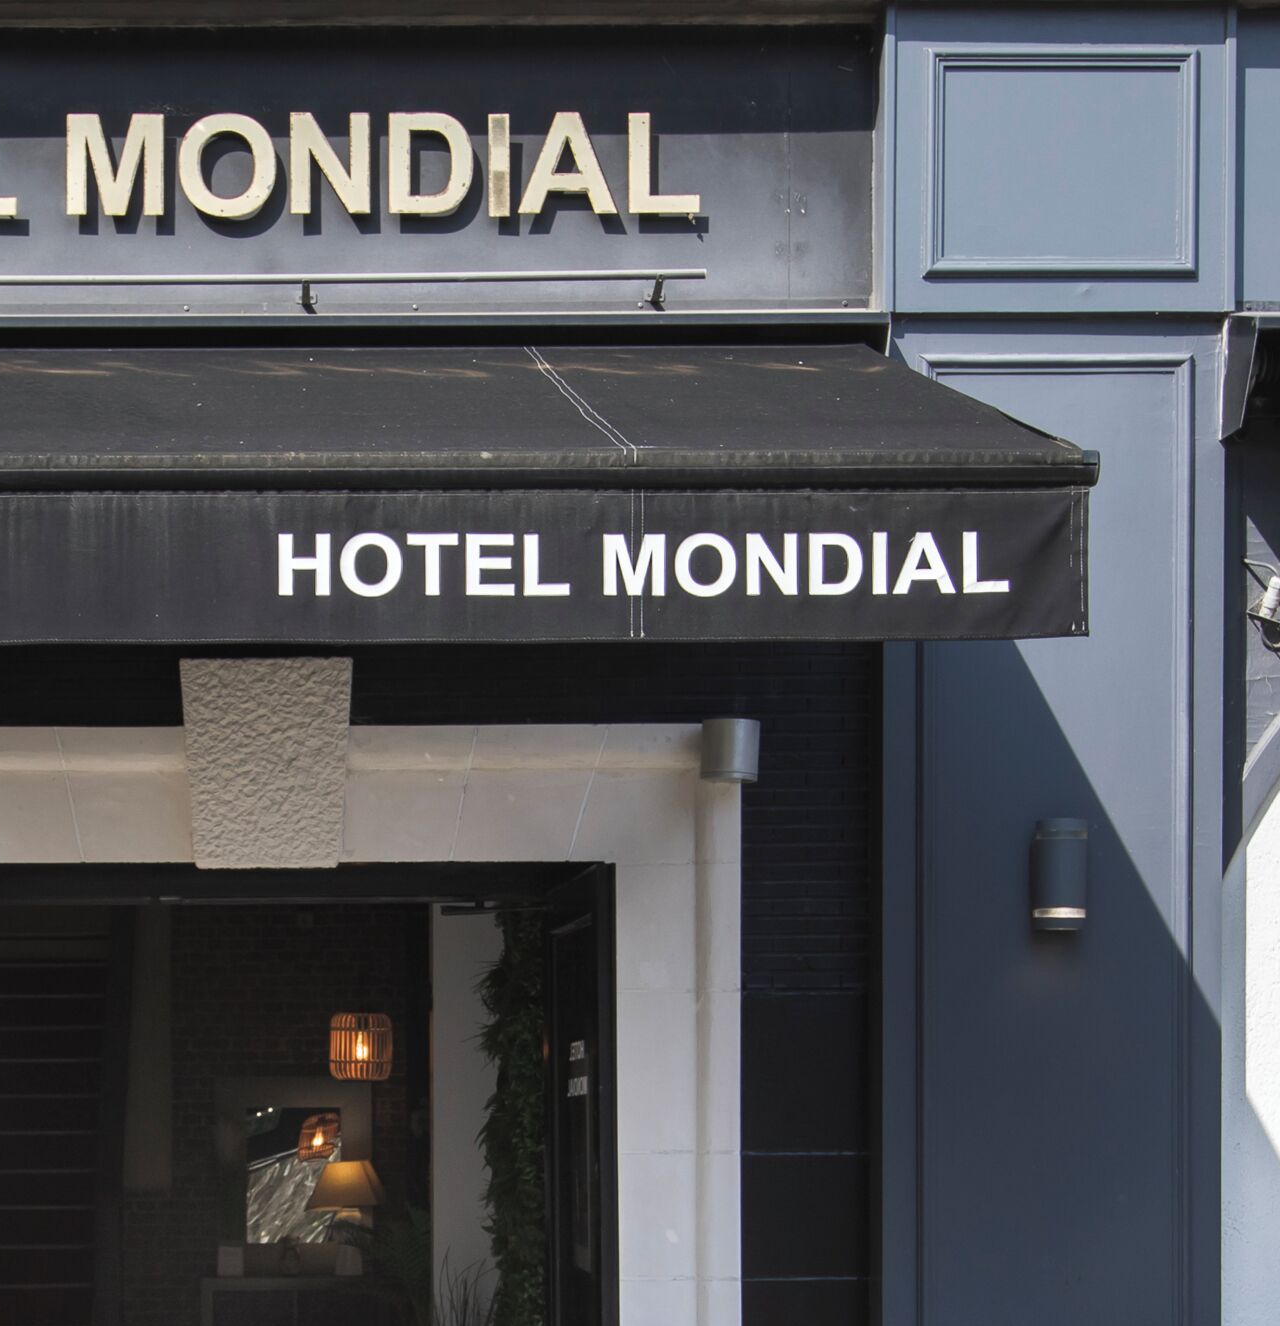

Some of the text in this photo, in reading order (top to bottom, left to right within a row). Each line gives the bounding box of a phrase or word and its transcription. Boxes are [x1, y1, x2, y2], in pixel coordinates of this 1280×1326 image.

[64, 111, 701, 219] MONDIAL
[277, 530, 1010, 598] HOTEL MONDIAL
